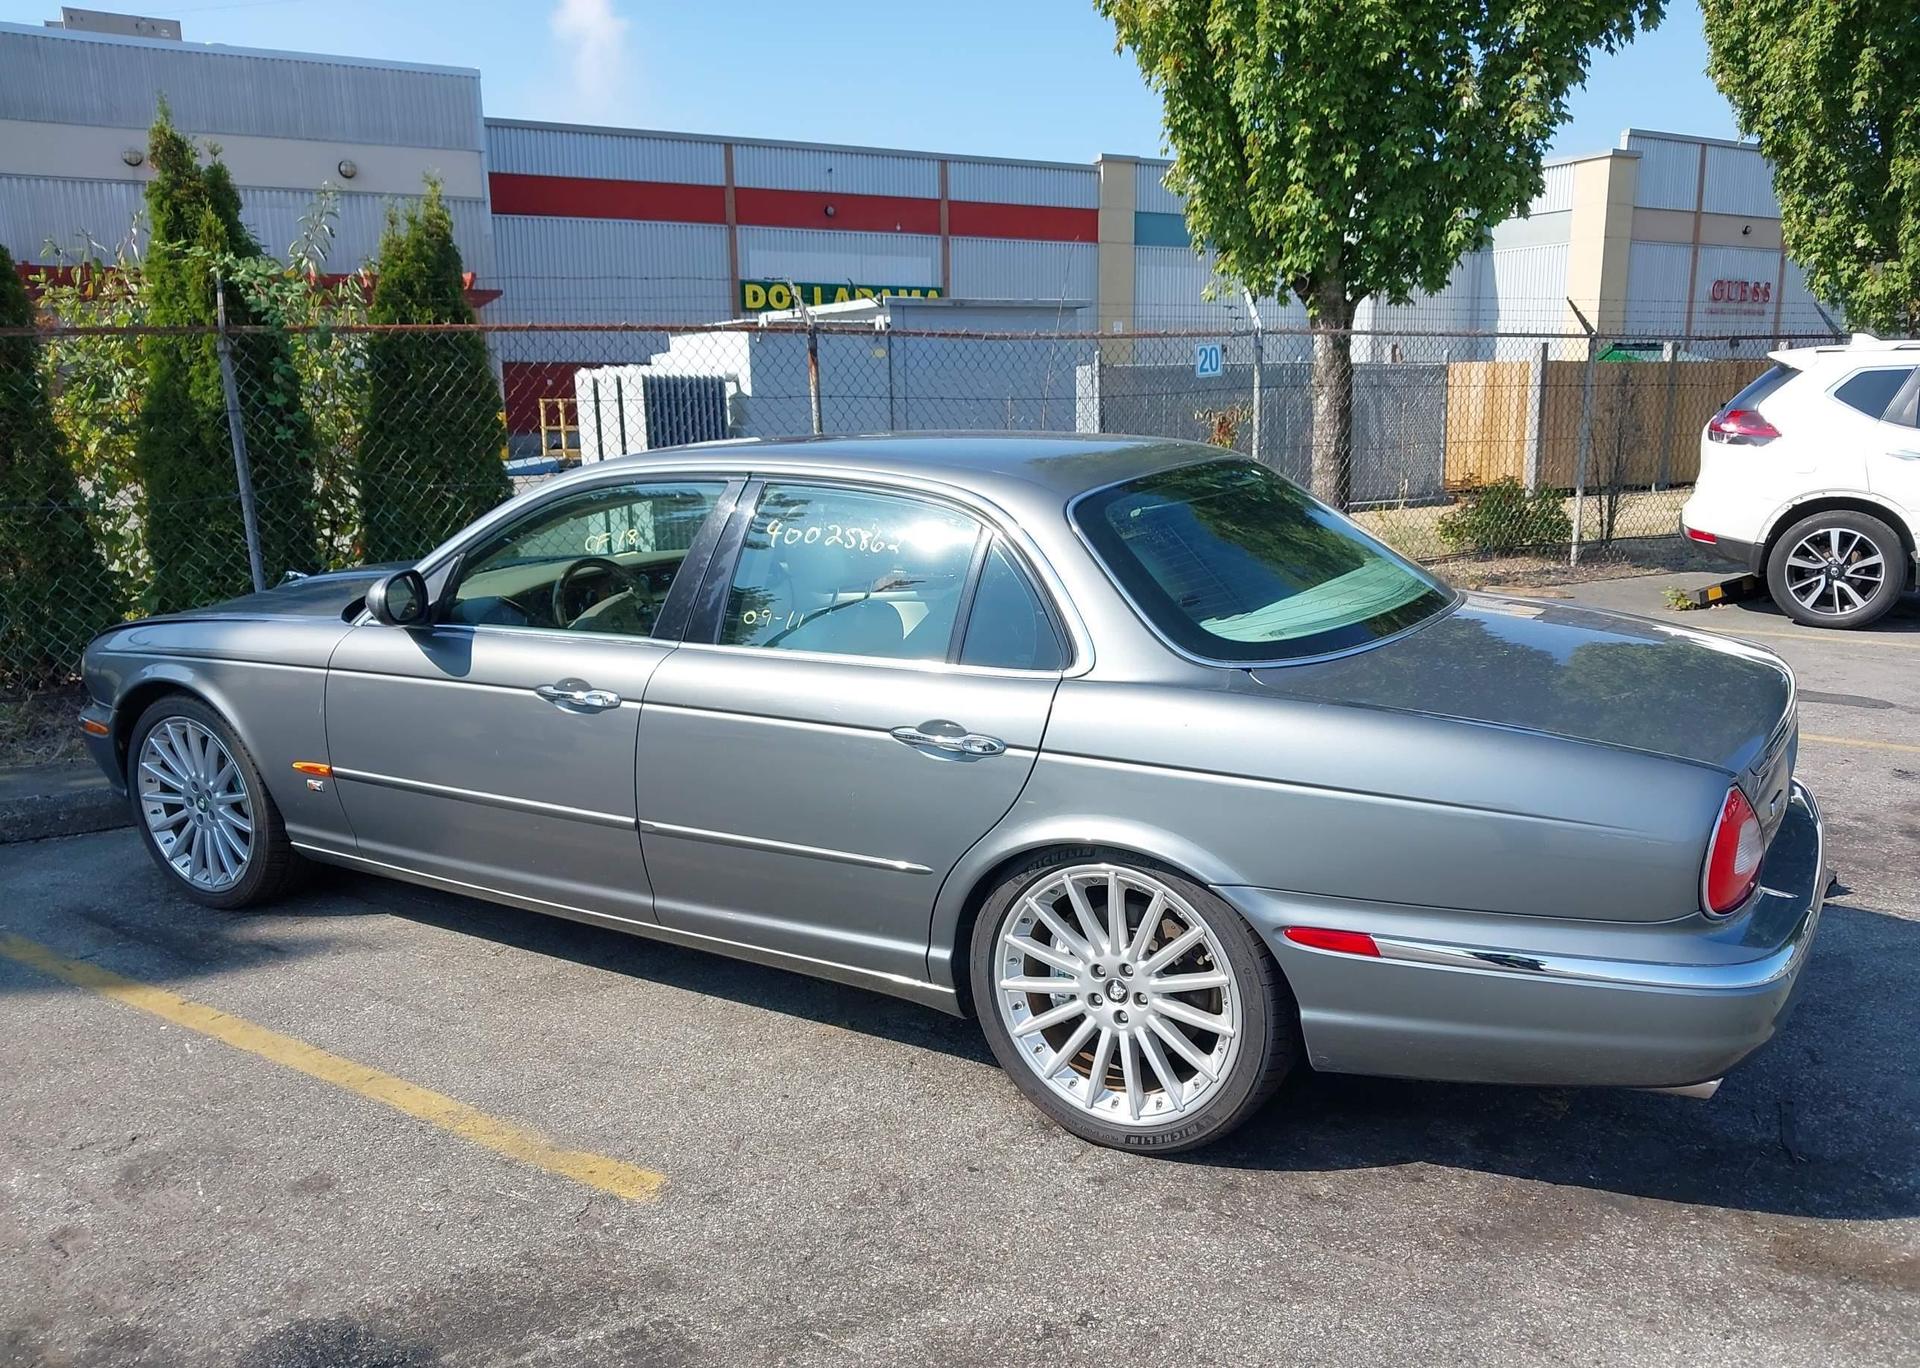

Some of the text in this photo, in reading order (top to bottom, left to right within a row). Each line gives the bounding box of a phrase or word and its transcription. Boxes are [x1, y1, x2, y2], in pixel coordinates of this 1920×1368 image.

[1712, 280, 1771, 302] GUESS
[1199, 347, 1219, 372] 20
[743, 610, 805, 630] 09-11
[1129, 1124, 1199, 1144] MICHELIN
